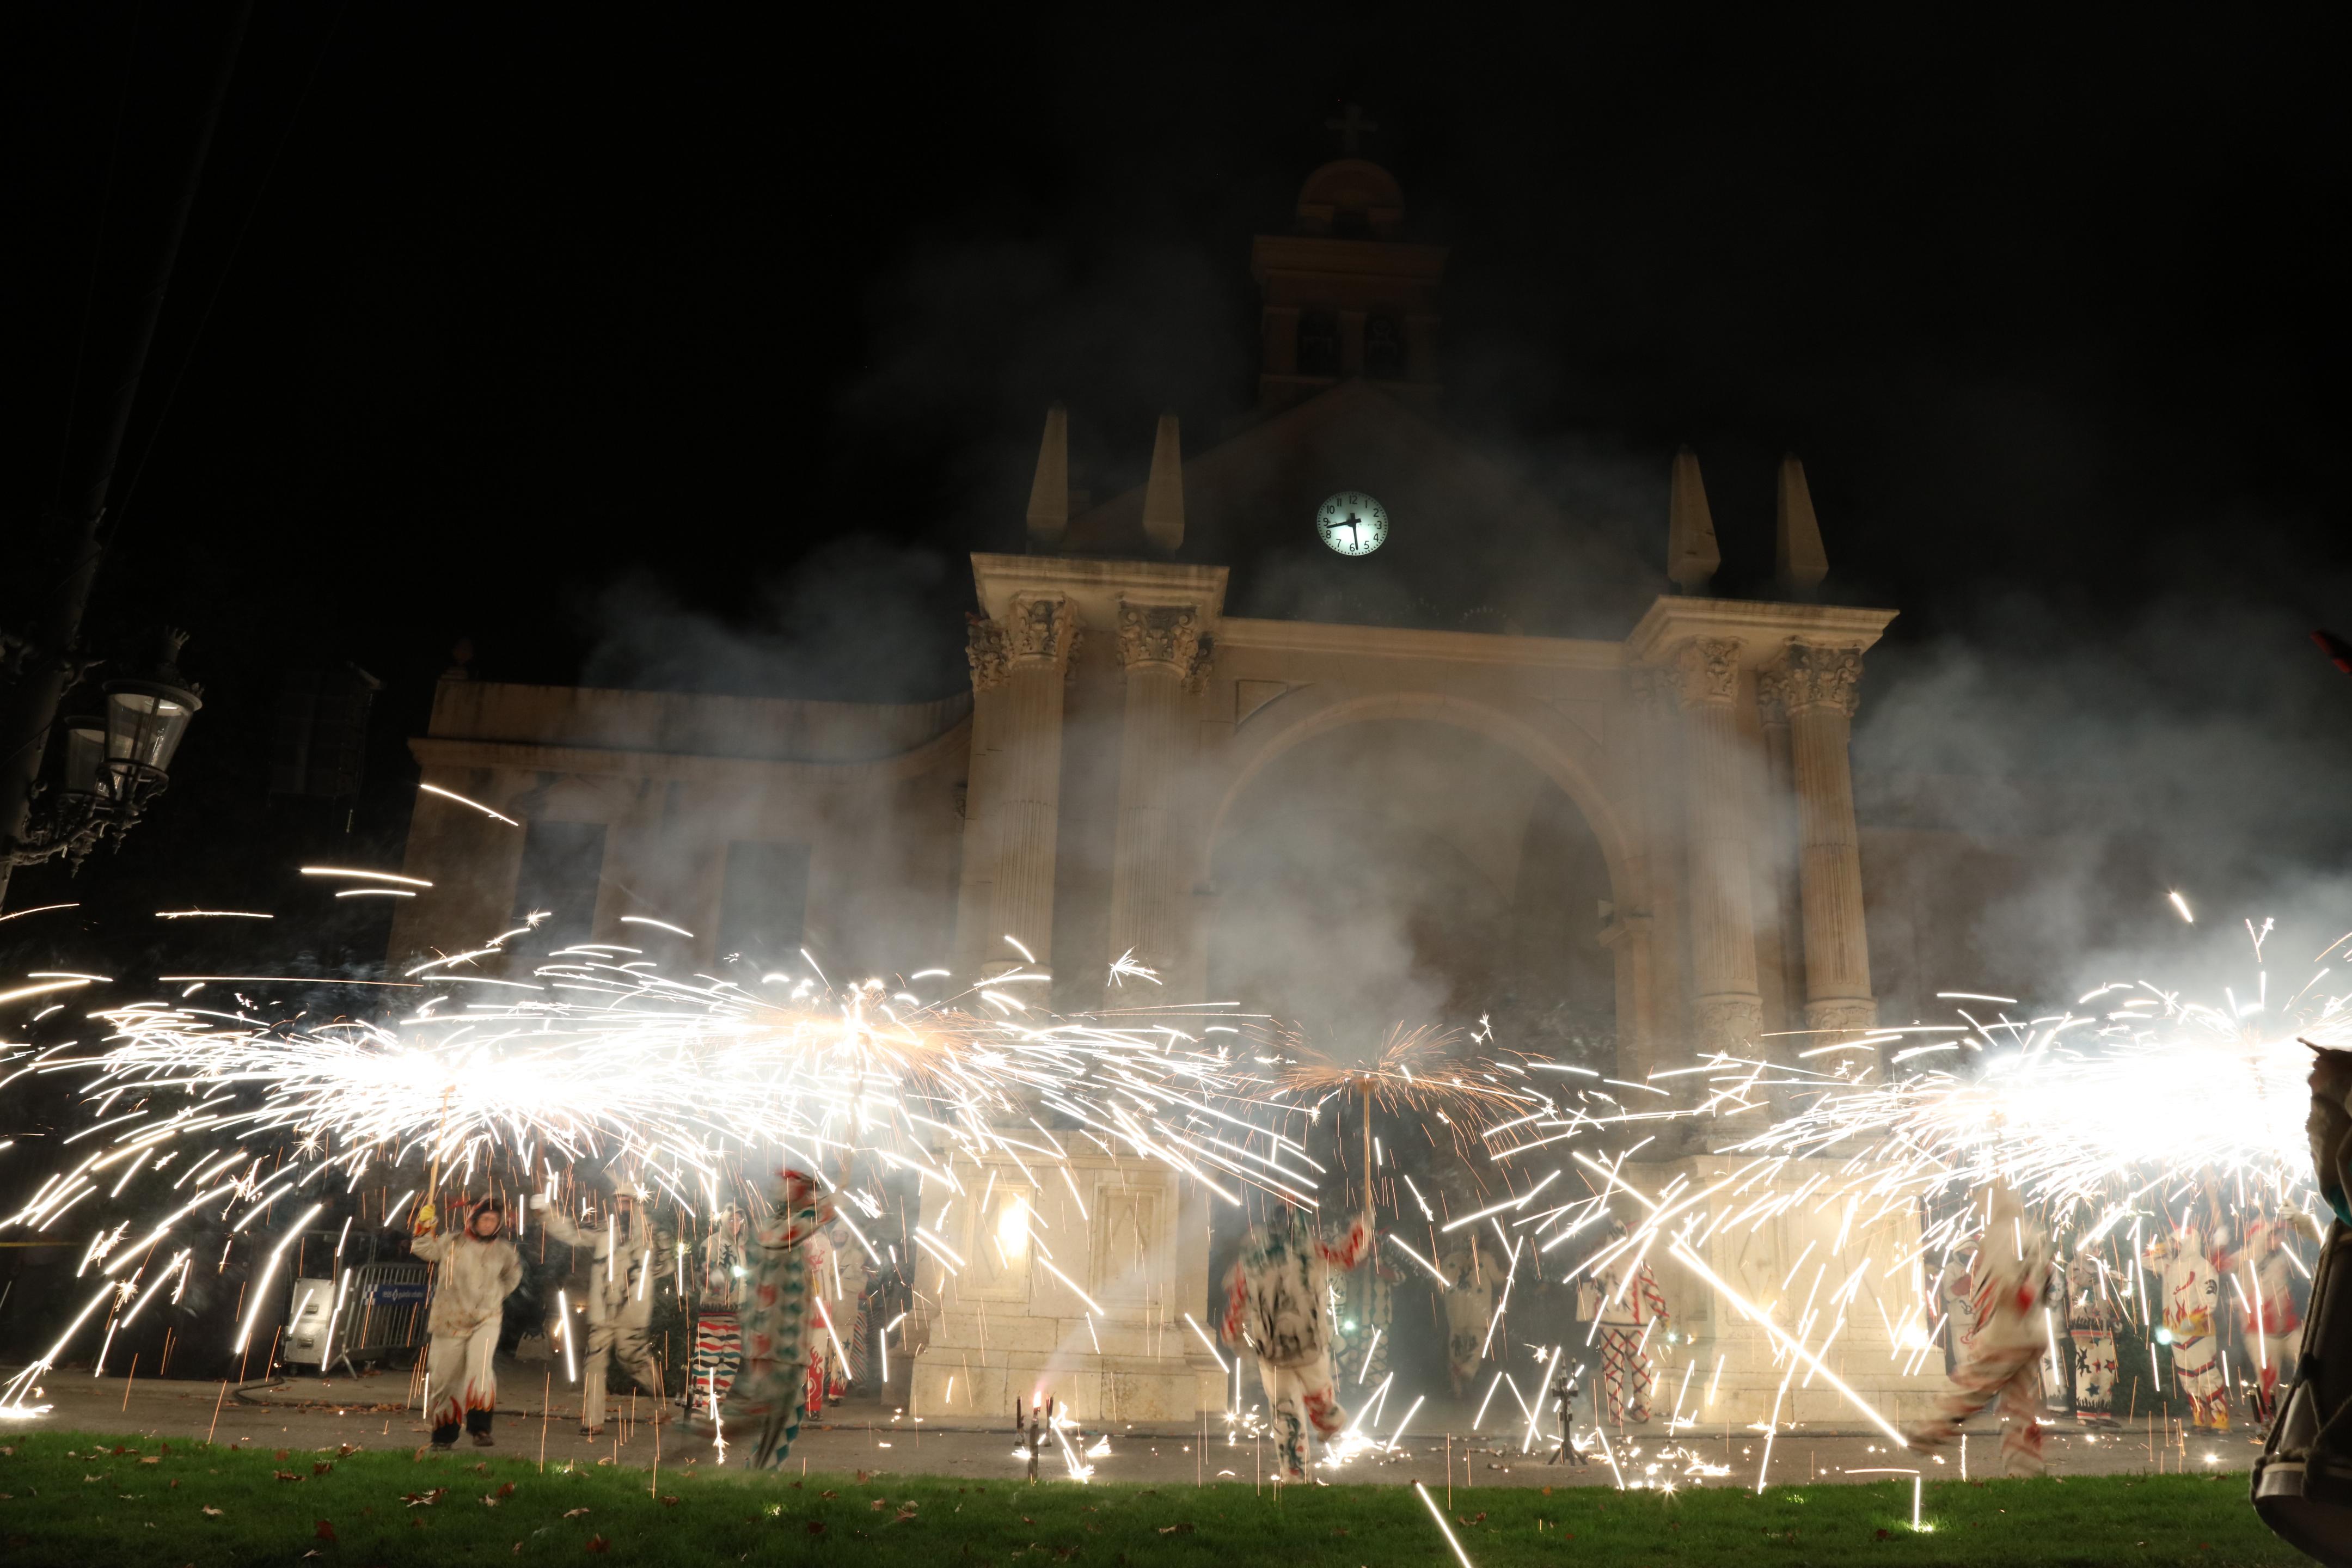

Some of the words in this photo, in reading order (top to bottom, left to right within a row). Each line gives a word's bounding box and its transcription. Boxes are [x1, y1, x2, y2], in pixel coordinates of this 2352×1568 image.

[1337, 498, 1342, 507] 11
[1349, 494, 1357, 505] 12
[1364, 500, 1368, 509] 1
[1326, 505, 1335, 514] 10
[1373, 508, 1379, 517] 2
[1323, 517, 1328, 526] 9
[1376, 520, 1382, 530] 3
[1326, 530, 1331, 539] 8
[1373, 533, 1379, 542] 4
[1336, 538, 1342, 548] 7
[1349, 543, 1355, 552] 6
[1364, 541, 1369, 549] 5
